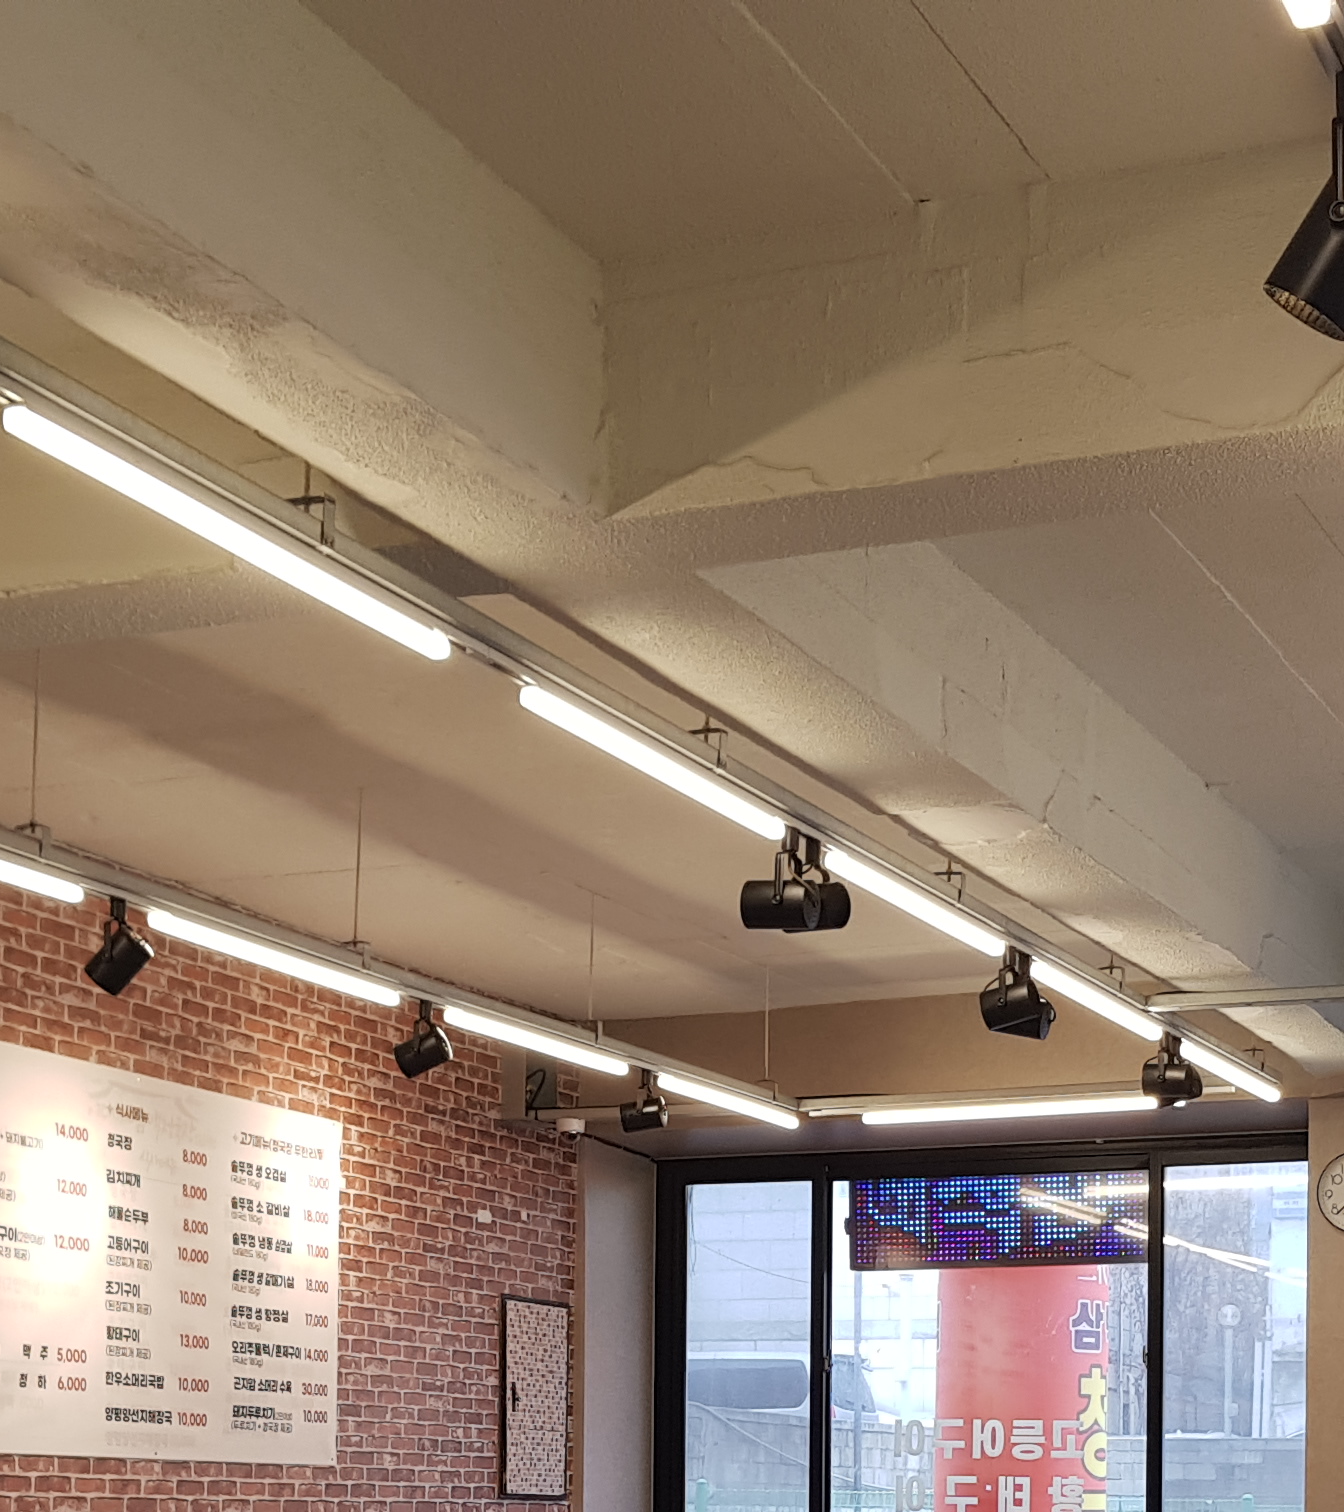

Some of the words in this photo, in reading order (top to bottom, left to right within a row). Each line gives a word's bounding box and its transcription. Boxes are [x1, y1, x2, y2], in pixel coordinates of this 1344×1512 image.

[55, 1122, 88, 1142] 14,000
[108, 1133, 132, 1150] 청국장
[183, 1149, 207, 1167] 8,000
[1331, 1174, 1343, 1185] 10
[57, 1179, 87, 1197] 12,000
[183, 1184, 207, 1201] 8,000
[1325, 1190, 1333, 1199] 9
[257, 1201, 264, 1213] 소
[1331, 1203, 1338, 1215] 8
[109, 1205, 148, 1225] 해물순두부
[183, 1219, 208, 1235] 8,000
[54, 1235, 90, 1252] 12,000
[107, 1235, 149, 1254] 고등어구이
[178, 1247, 209, 1264] 10,000
[307, 1244, 328, 1259] 11,000
[106, 1281, 140, 1298] 조기구이
[180, 1290, 206, 1306] 10,000
[305, 1313, 328, 1328] 17,000
[107, 1326, 140, 1343] 황태구이
[180, 1334, 209, 1349] 13,000
[57, 1348, 87, 1363] 5,000
[304, 1348, 328, 1362] 14,000
[58, 1377, 87, 1392] 6,000
[106, 1372, 164, 1389] 한우소머리국밥
[178, 1377, 209, 1392] 10,000
[302, 1383, 328, 1396] 30,000
[178, 1412, 207, 1427] 10,000
[303, 1410, 327, 1423] 10,000
